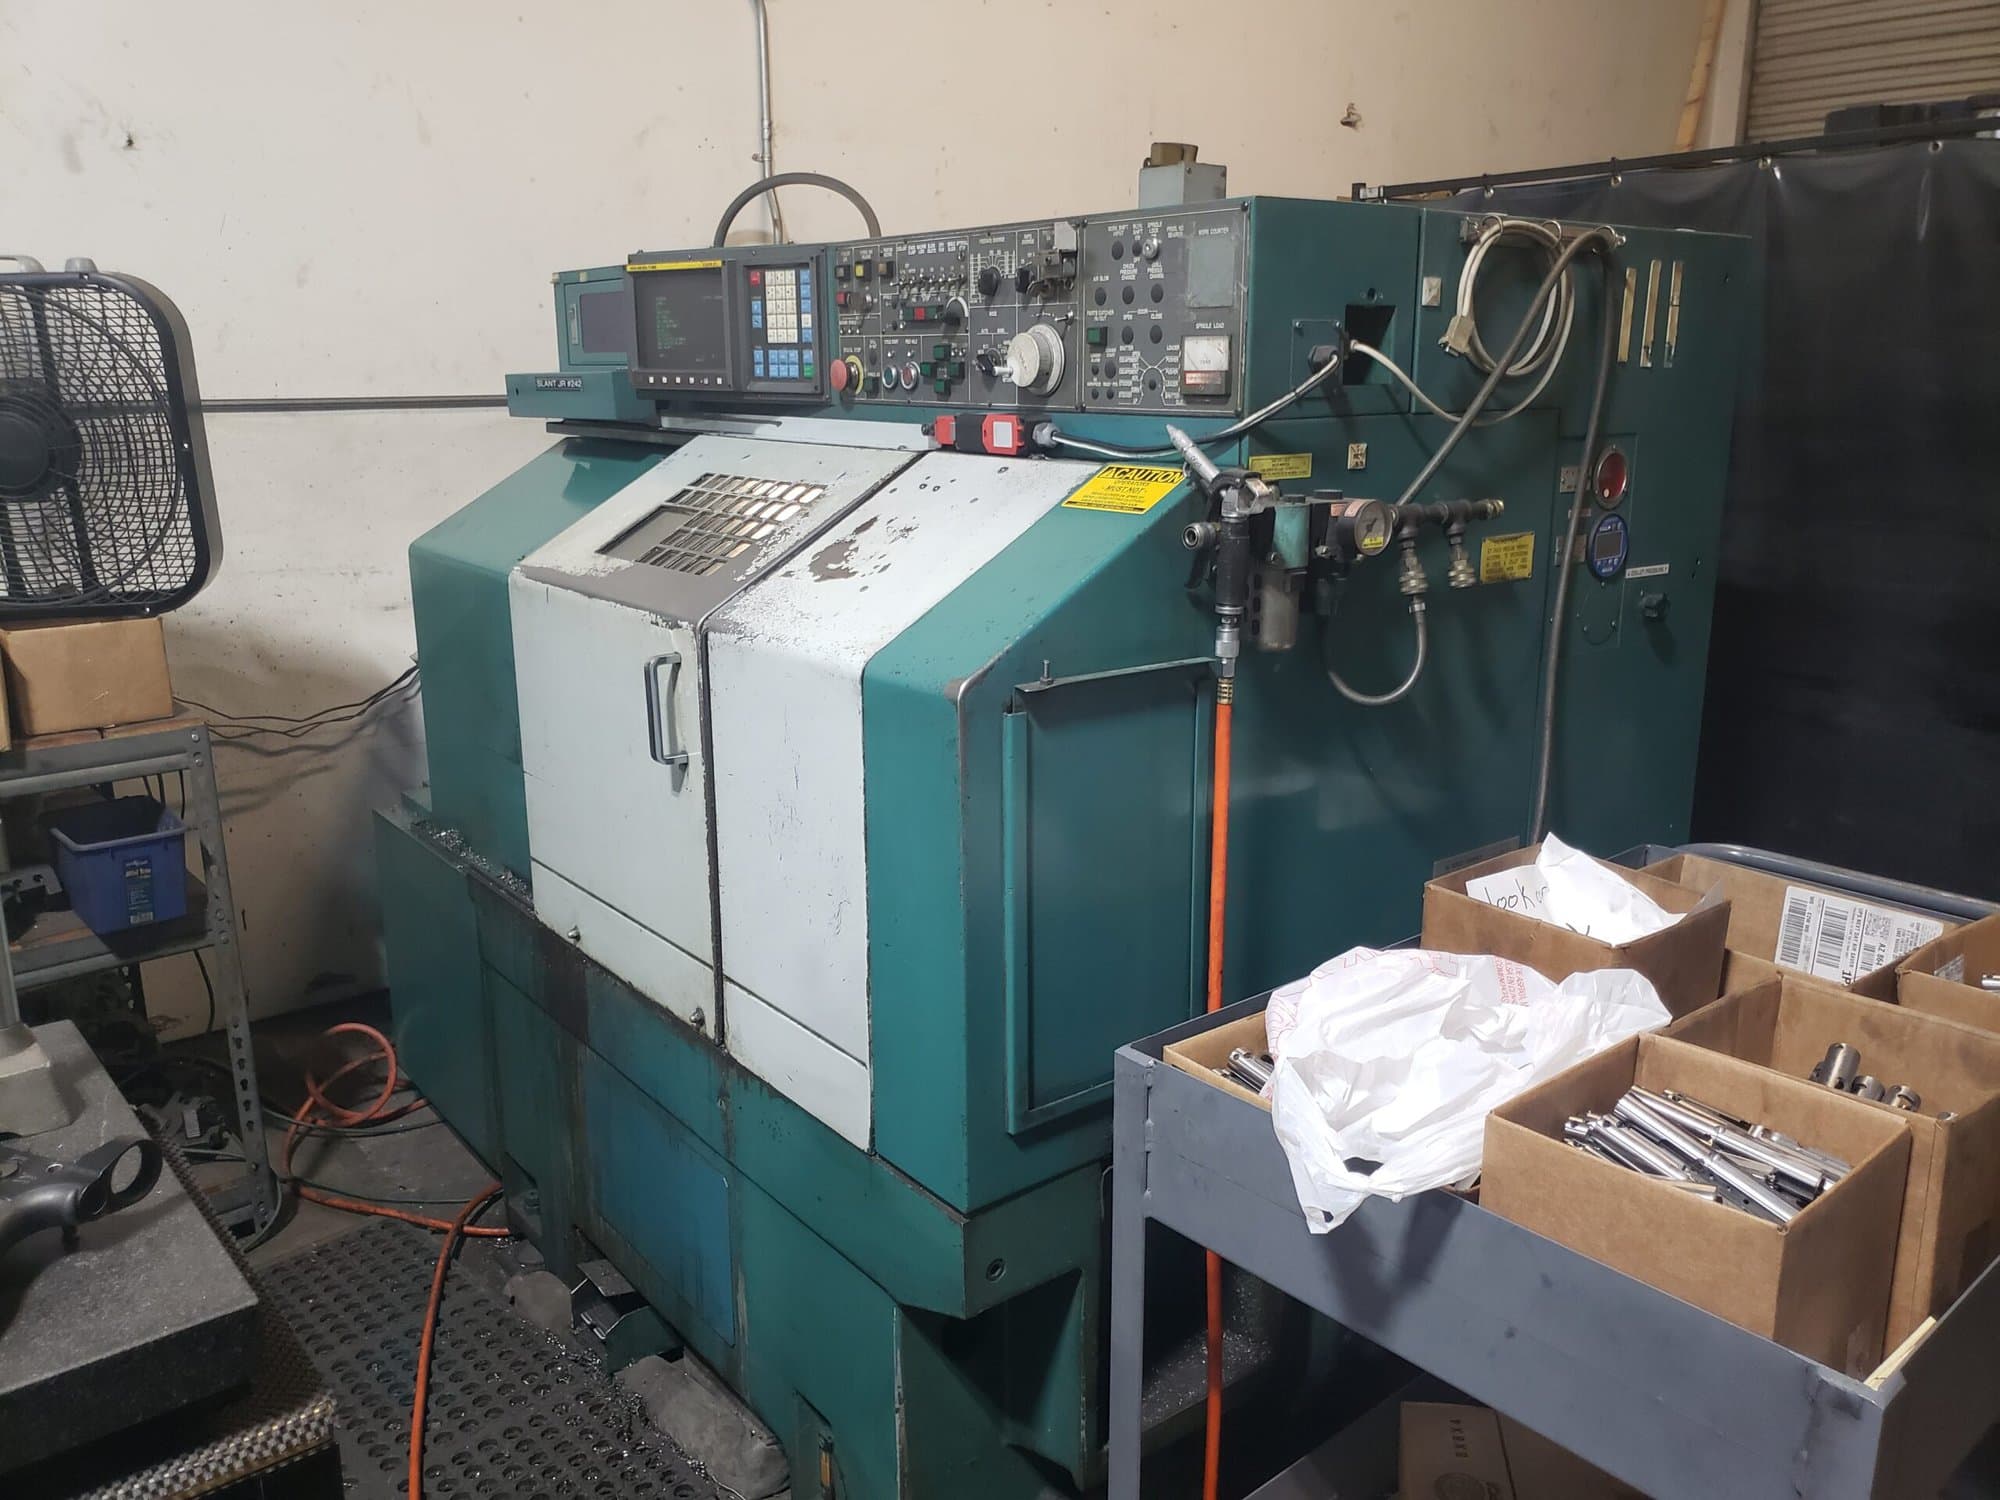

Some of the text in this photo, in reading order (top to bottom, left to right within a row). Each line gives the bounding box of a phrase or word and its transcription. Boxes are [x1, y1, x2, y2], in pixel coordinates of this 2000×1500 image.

[536, 378, 583, 387] SLANT JR #242
[1115, 468, 1185, 484] CAUTION
[1106, 485, 1127, 493] MUST
[1879, 942, 1887, 954] AZ
